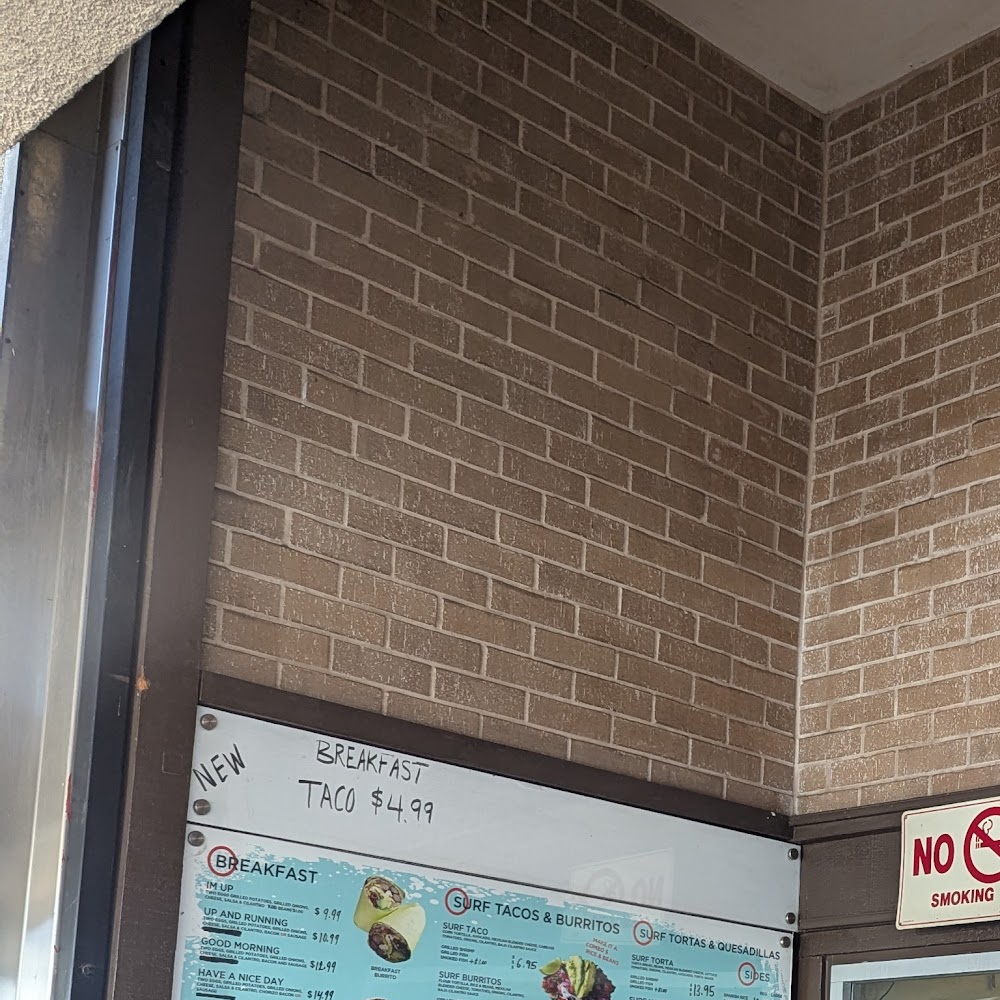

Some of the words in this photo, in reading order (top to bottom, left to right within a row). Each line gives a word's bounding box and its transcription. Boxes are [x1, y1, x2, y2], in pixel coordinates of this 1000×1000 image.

[193, 744, 246, 792] NEW
[316, 740, 429, 784] BREAKFAST
[298, 779, 355, 813] TACO
[371, 787, 434, 824] $4.99
[913, 833, 955, 876] NO
[216, 854, 317, 883] BREAKFAST
[205, 881, 217, 891] IM
[220, 883, 233, 891] UP
[930, 887, 995, 908] SMOKING
[203, 907, 218, 918] UP
[219, 910, 241, 919] AND
[244, 913, 287, 926] RUNNING
[453, 896, 490, 912] SURF
[495, 903, 538, 920] TACOS
[543, 911, 551, 923] &
[556, 913, 619, 934] BURRITOS
[442, 922, 464, 930] SURF
[466, 925, 488, 935] TACO
[200, 937, 231, 949] GOOD
[234, 941, 279, 954] MORNING
[640, 928, 666, 941] SURF
[668, 933, 706, 947] TORTAS
[708, 940, 714, 949] &
[717, 941, 780, 959] QUESADILLAS
[631, 954, 649, 964] SURF
[651, 956, 673, 966] TORTA
[197, 969, 225, 981] HAVE
[228, 972, 235, 982] A
[237, 973, 261, 985] NICE
[263, 976, 283, 985] DAY
[438, 970, 460, 982] SURF
[462, 973, 501, 985] BURRITOS
[744, 970, 769, 982] SIDES
